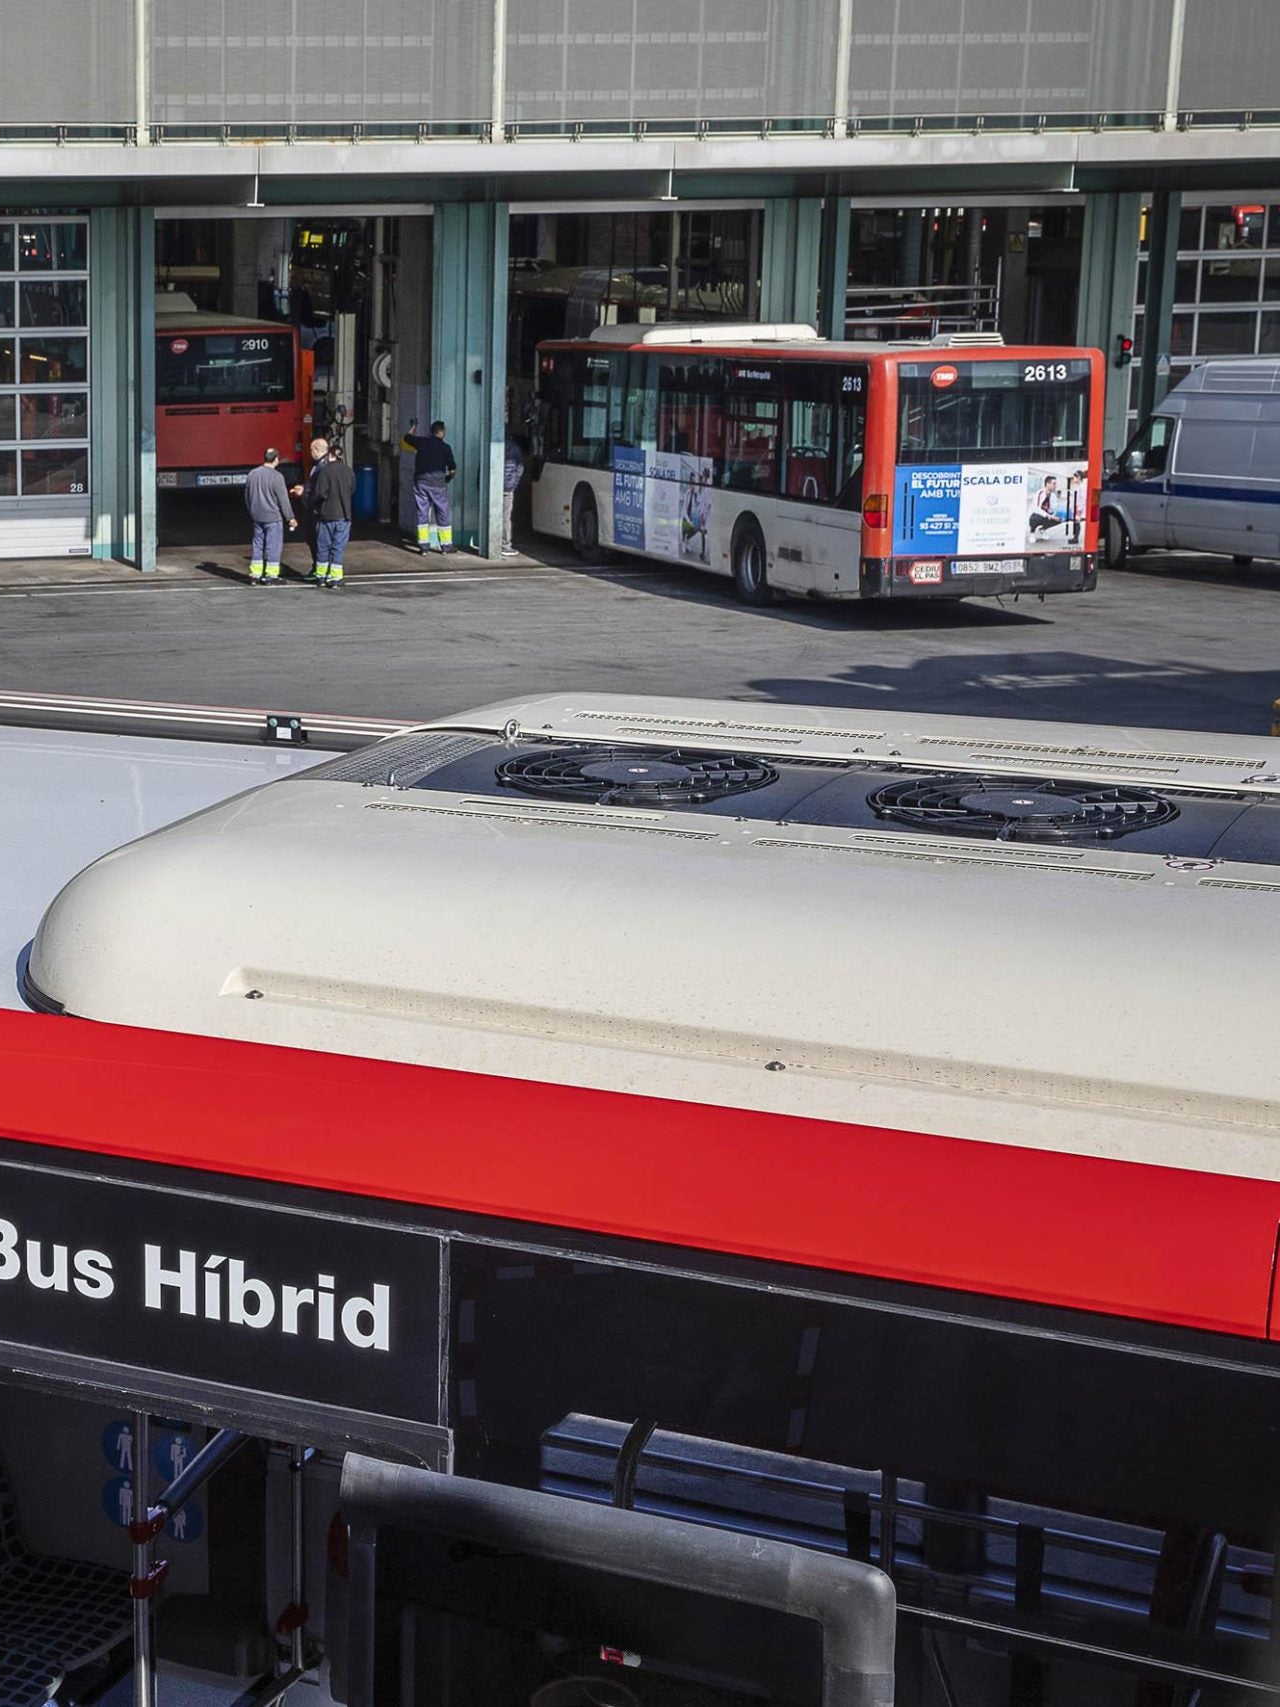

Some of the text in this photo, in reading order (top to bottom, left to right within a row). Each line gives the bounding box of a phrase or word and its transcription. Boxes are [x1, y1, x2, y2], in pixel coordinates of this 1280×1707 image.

[241, 339, 269, 350] 2910
[936, 372, 955, 381] TMB
[1024, 364, 1067, 382] 2613
[842, 376, 862, 391] 2613
[912, 472, 962, 480] DESCOBRINT
[963, 475, 1023, 486] SCALA DEI
[70, 483, 84, 493] 28
[912, 479, 961, 489] EL FUTUR
[920, 489, 944, 499] AMB
[144, 1243, 390, 1351] Híbrid
